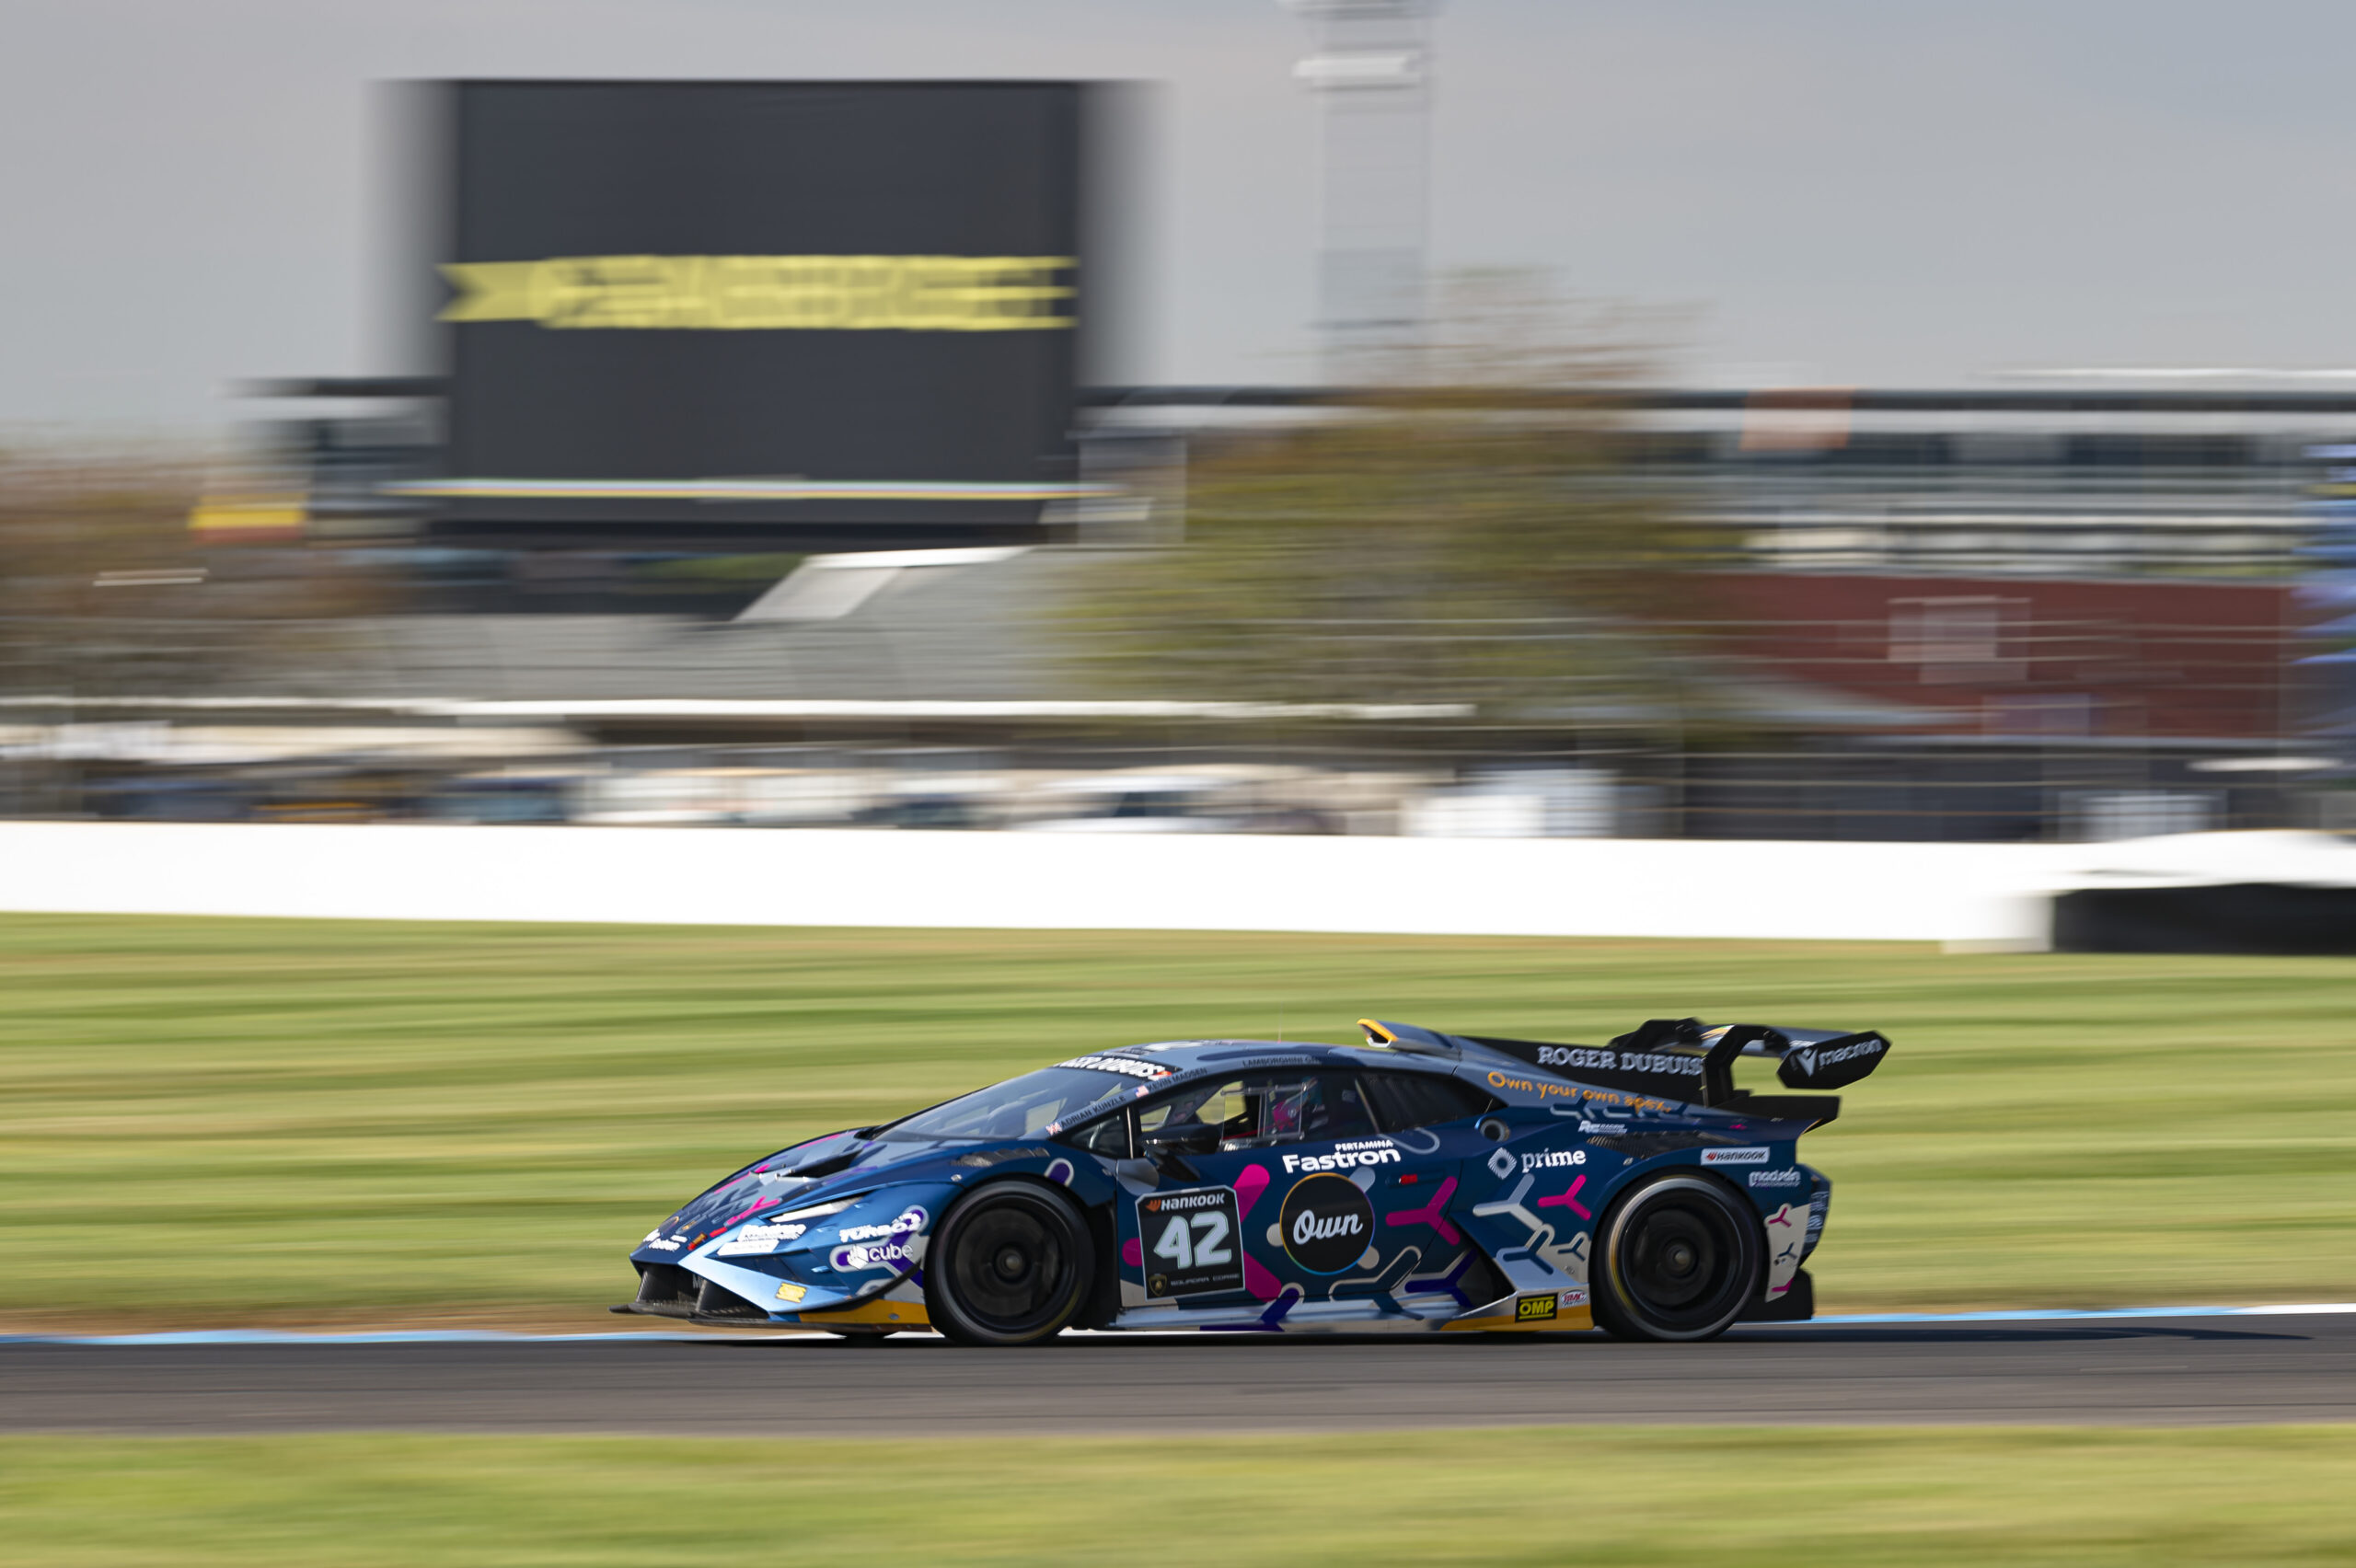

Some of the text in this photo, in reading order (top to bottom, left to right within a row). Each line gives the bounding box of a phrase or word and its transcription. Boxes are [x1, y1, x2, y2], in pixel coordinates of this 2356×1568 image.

[1536, 1045, 1703, 1076] ROGER DUBUIS
[1818, 1038, 1883, 1066] macron
[1486, 1070, 1533, 1093] Own
[1536, 1081, 1578, 1100] your
[1582, 1089, 1620, 1105] own
[1060, 1110, 1093, 1129] ADRIAN
[1334, 1139, 1393, 1151] PERTAMINA
[1282, 1148, 1401, 1174] Fastron
[1521, 1147, 1587, 1173] prime
[1153, 1210, 1232, 1270] 42
[1293, 1209, 1364, 1245] Own
[868, 1243, 914, 1262] cube
[1519, 1300, 1554, 1315] OMP
